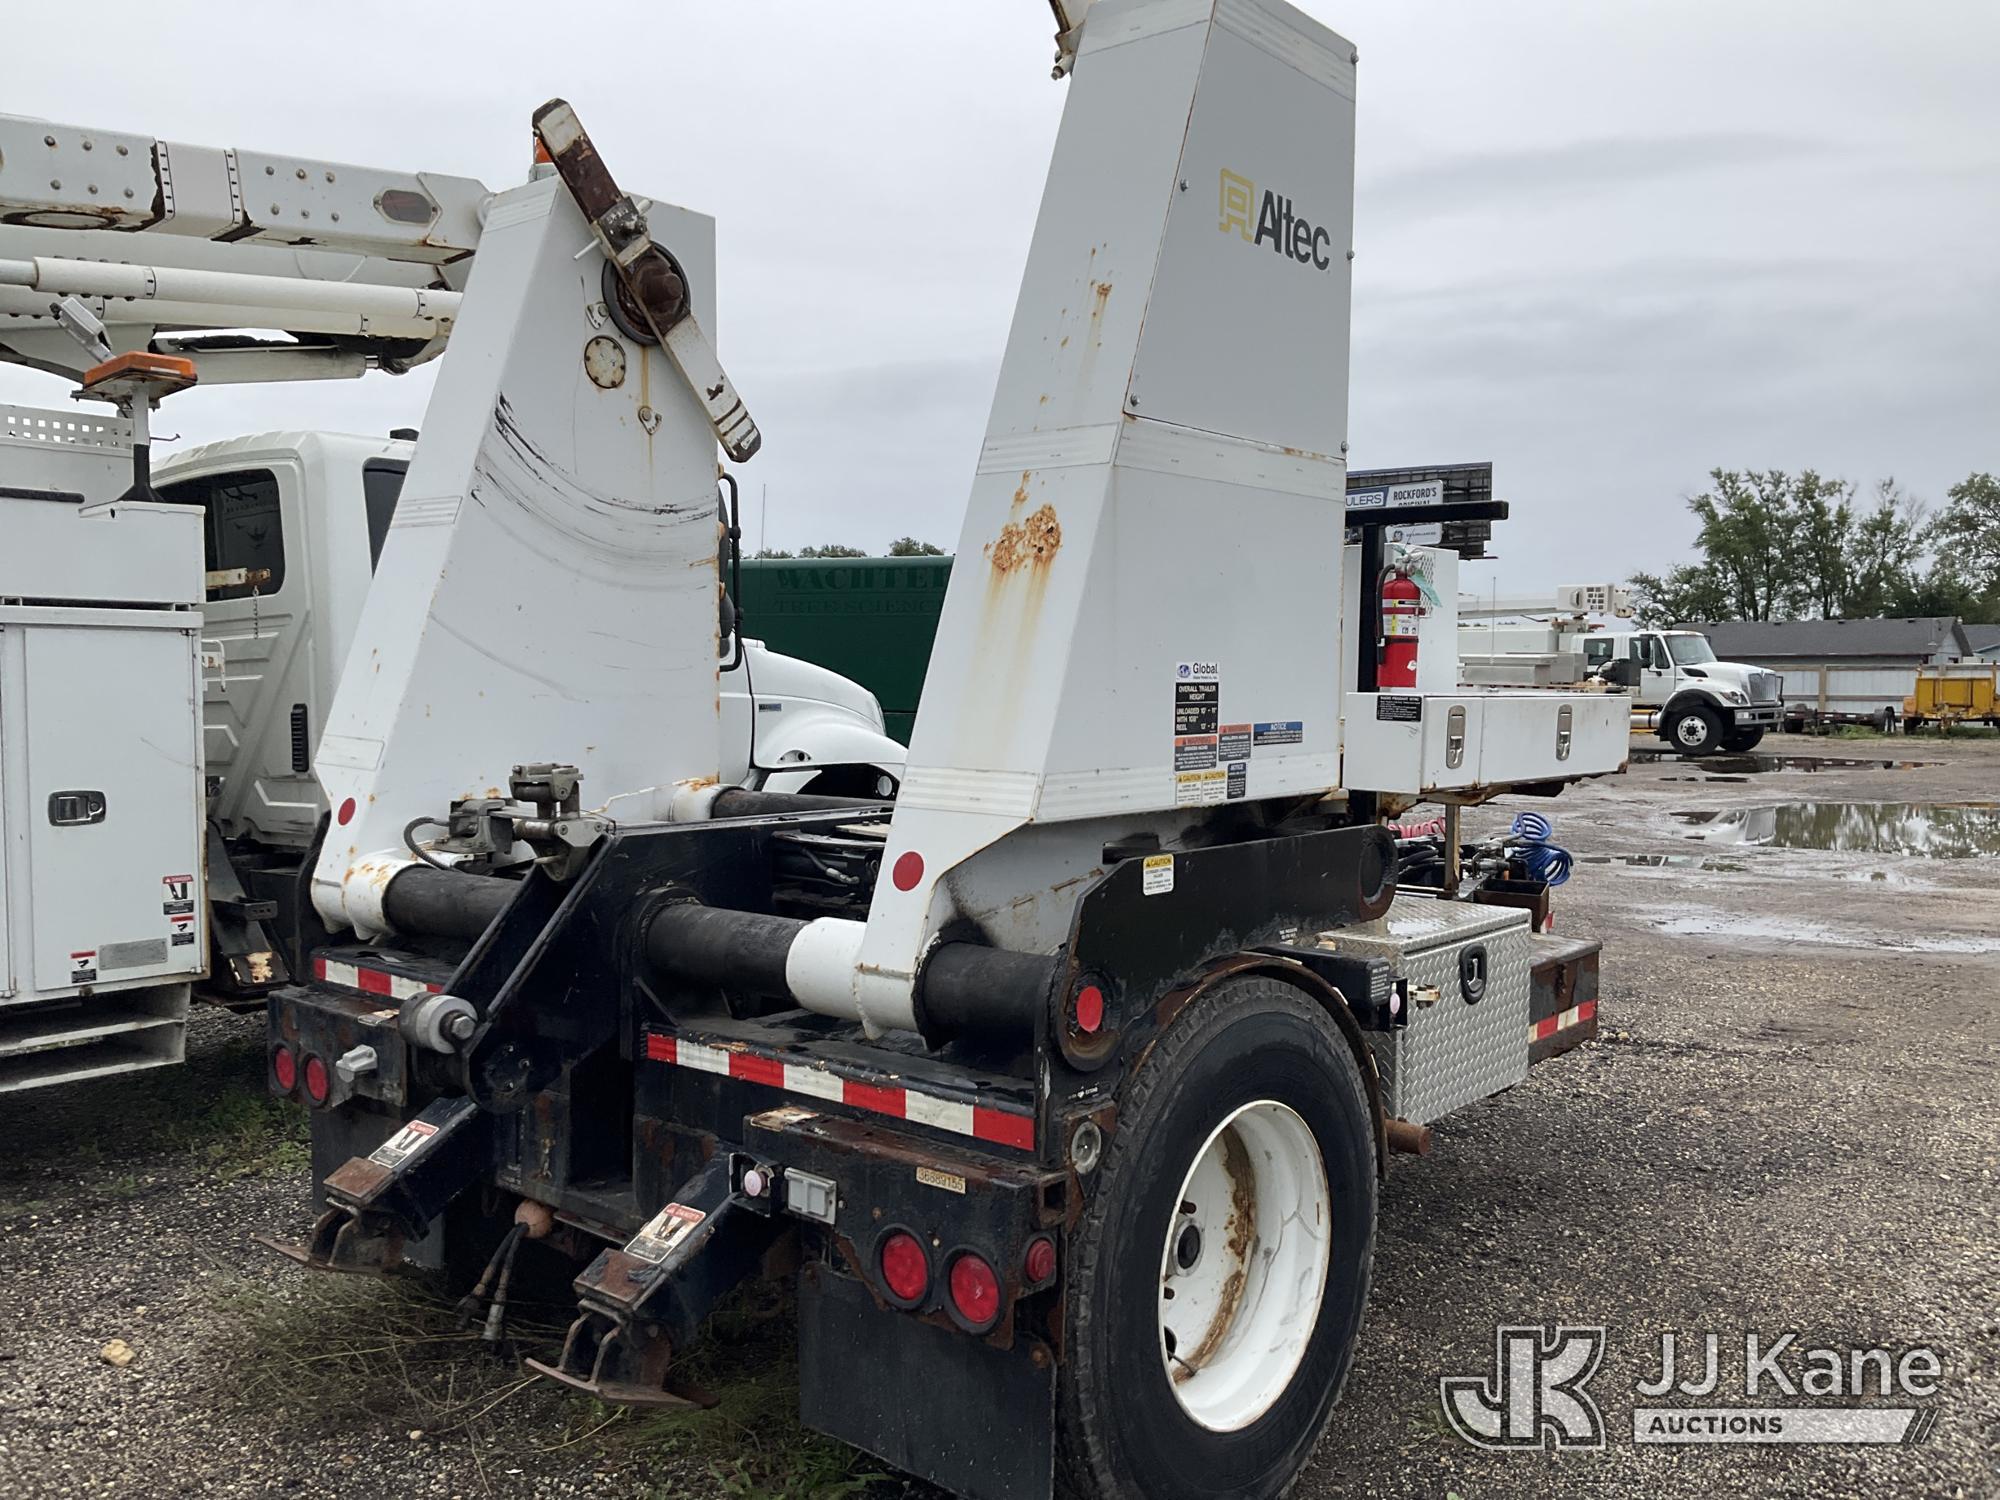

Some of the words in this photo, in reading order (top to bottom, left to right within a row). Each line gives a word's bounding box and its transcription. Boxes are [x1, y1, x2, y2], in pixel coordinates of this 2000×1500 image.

[1254, 189, 1330, 271] Altec
[1393, 487, 1437, 501] ROCKFORD'S
[1192, 662, 1218, 674] Global
[1178, 685, 1198, 693] OVERALL
[1198, 684, 1217, 692] TRAILER
[1176, 707, 1200, 715] UNLOADED
[1270, 722, 1287, 731] NOTICE
